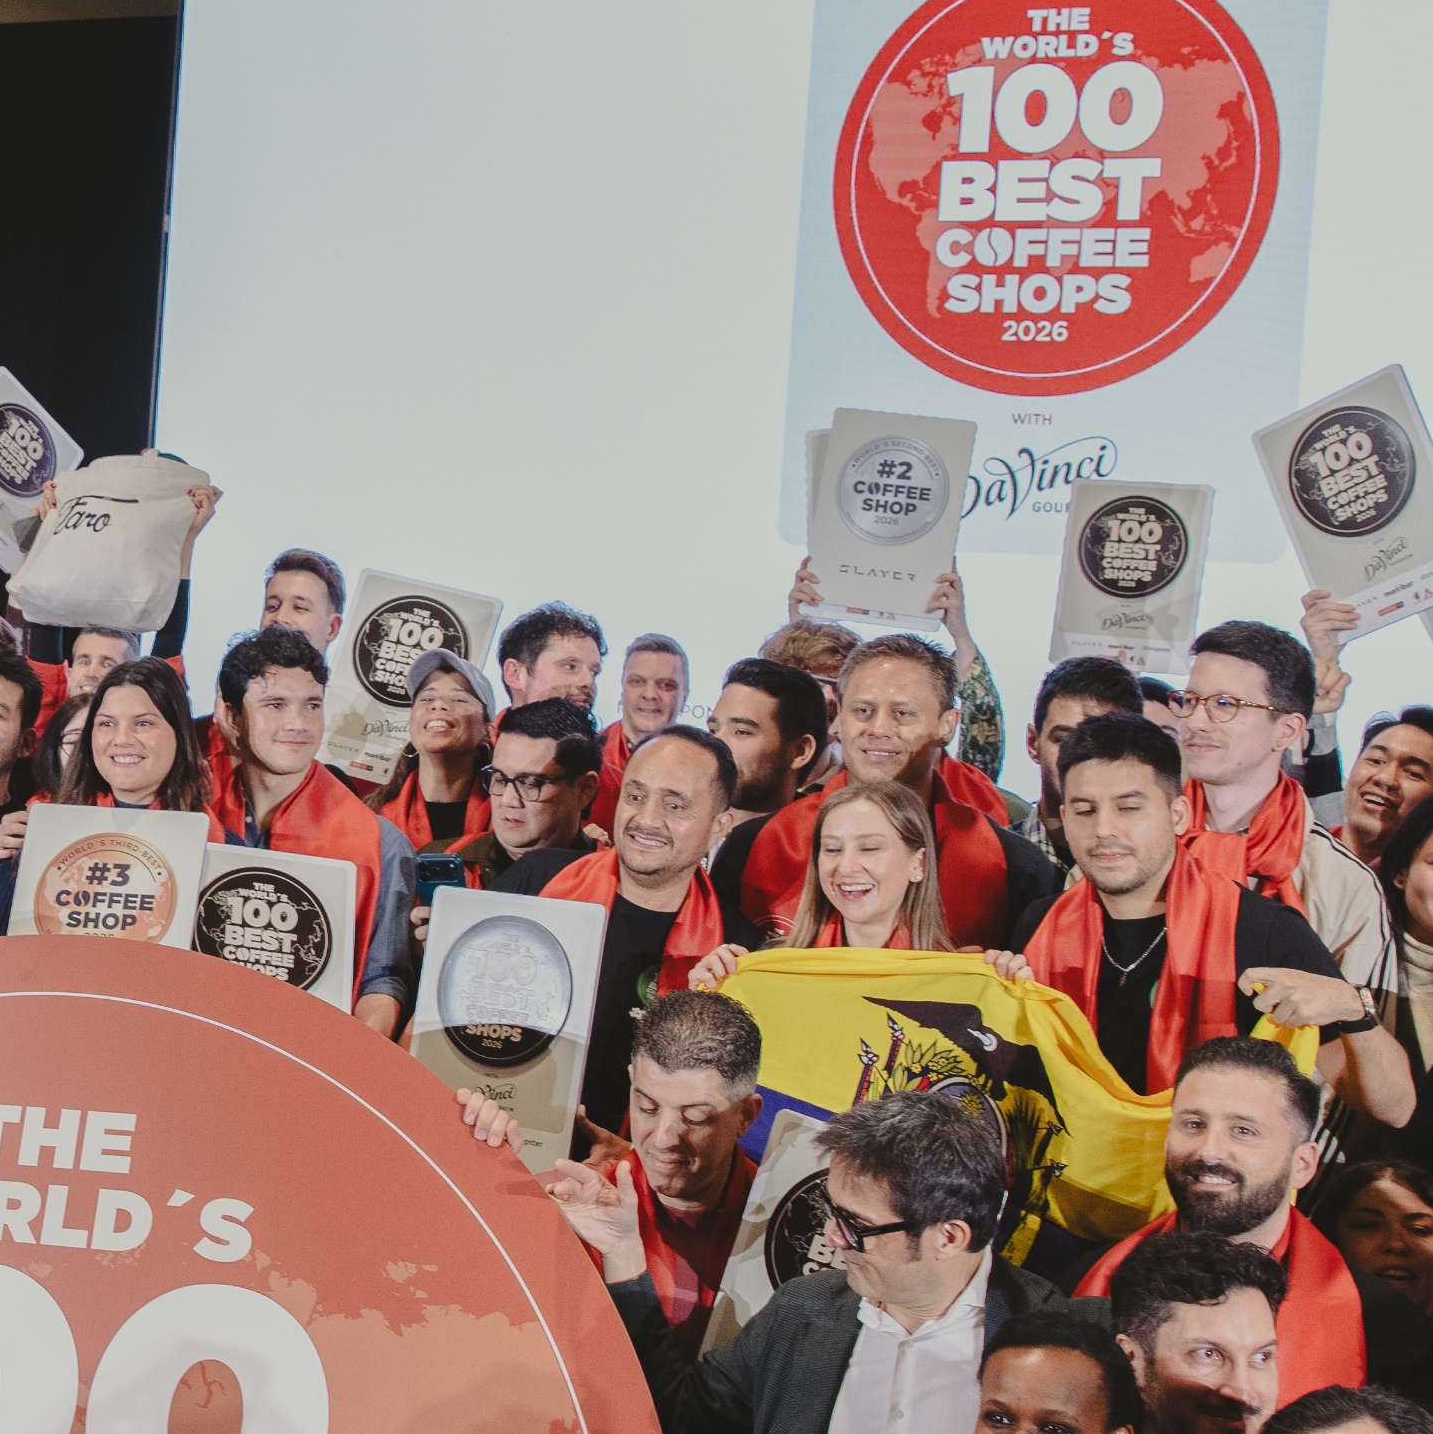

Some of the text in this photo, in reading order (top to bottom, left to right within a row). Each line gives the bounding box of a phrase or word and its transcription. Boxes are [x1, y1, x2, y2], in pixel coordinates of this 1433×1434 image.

[1027, 8, 1090, 31] THE
[946, 61, 1164, 154] 100
[938, 158, 1161, 222] BEST
[935, 227, 1150, 268] COFFEE
[943, 274, 1132, 315] SHOPS
[1001, 321, 1068, 342] 2026
[1012, 414, 1052, 425] WITH
[1321, 424, 1342, 437] THE
[6, 419, 44, 461] 100
[891, 440, 940, 474] SECOND-BEST
[1310, 432, 1373, 478] 100
[877, 460, 913, 481] #2
[1320, 454, 1381, 499] BEST
[853, 480, 931, 501] COFFEE
[1327, 474, 1387, 511] COFFEE
[861, 498, 917, 516] SHOP
[1335, 489, 1388, 522] SHOPS
[874, 516, 899, 525] 2026
[1108, 520, 1163, 544] 100
[1103, 541, 1161, 560] BEST
[1102, 557, 1158, 572] COFFEE
[1103, 570, 1152, 582] SHOPS
[413, 608, 431, 617] THE
[387, 619, 444, 650] 100
[110, 839, 162, 870] THIRD-BEST
[85, 862, 131, 887] #3
[253, 882, 275, 892] THE
[55, 890, 155, 912] COFFEE
[66, 911, 137, 931] SHOP
[227, 897, 298, 931] 100
[224, 925, 298, 953] BEST
[222, 946, 295, 968] COFFEE
[472, 950, 539, 986] 100
[467, 980, 535, 1011] BEST
[466, 1003, 530, 1024] COFFEE
[465, 1022, 523, 1042] SHOPS
[481, 1039, 503, 1049] 2026
